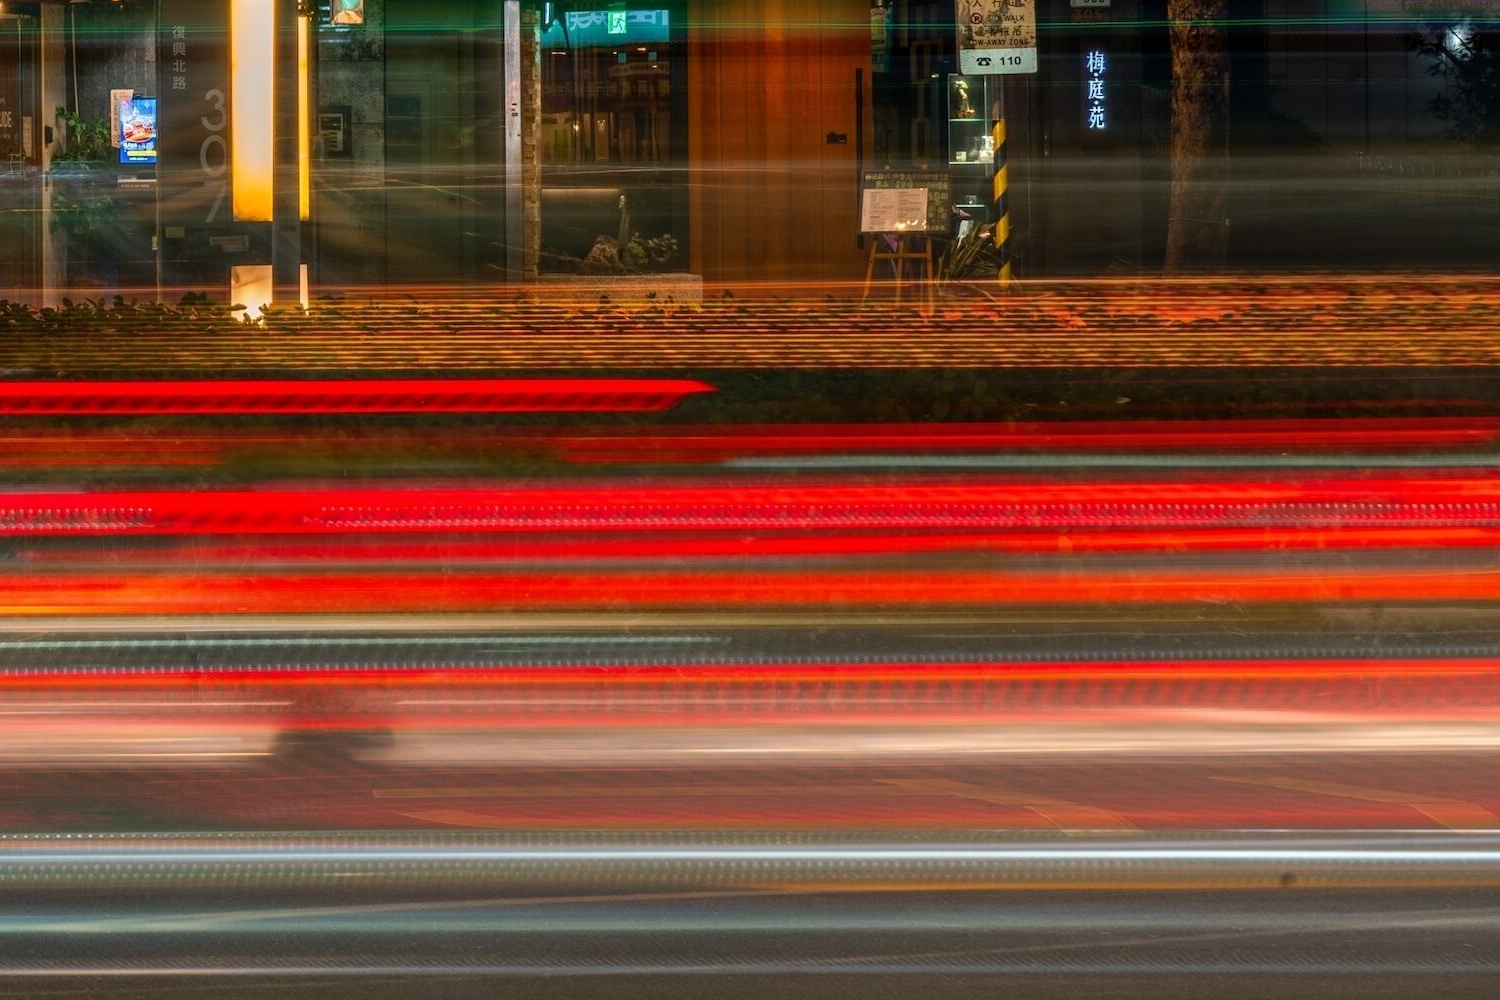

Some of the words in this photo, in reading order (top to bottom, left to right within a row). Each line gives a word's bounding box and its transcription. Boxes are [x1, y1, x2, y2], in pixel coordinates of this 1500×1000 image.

[987, 14, 1026, 22] SIDEWALK
[172, 25, 187, 90] 復興北路
[1000, 56, 1021, 66] 110
[200, 88, 227, 224] 307
